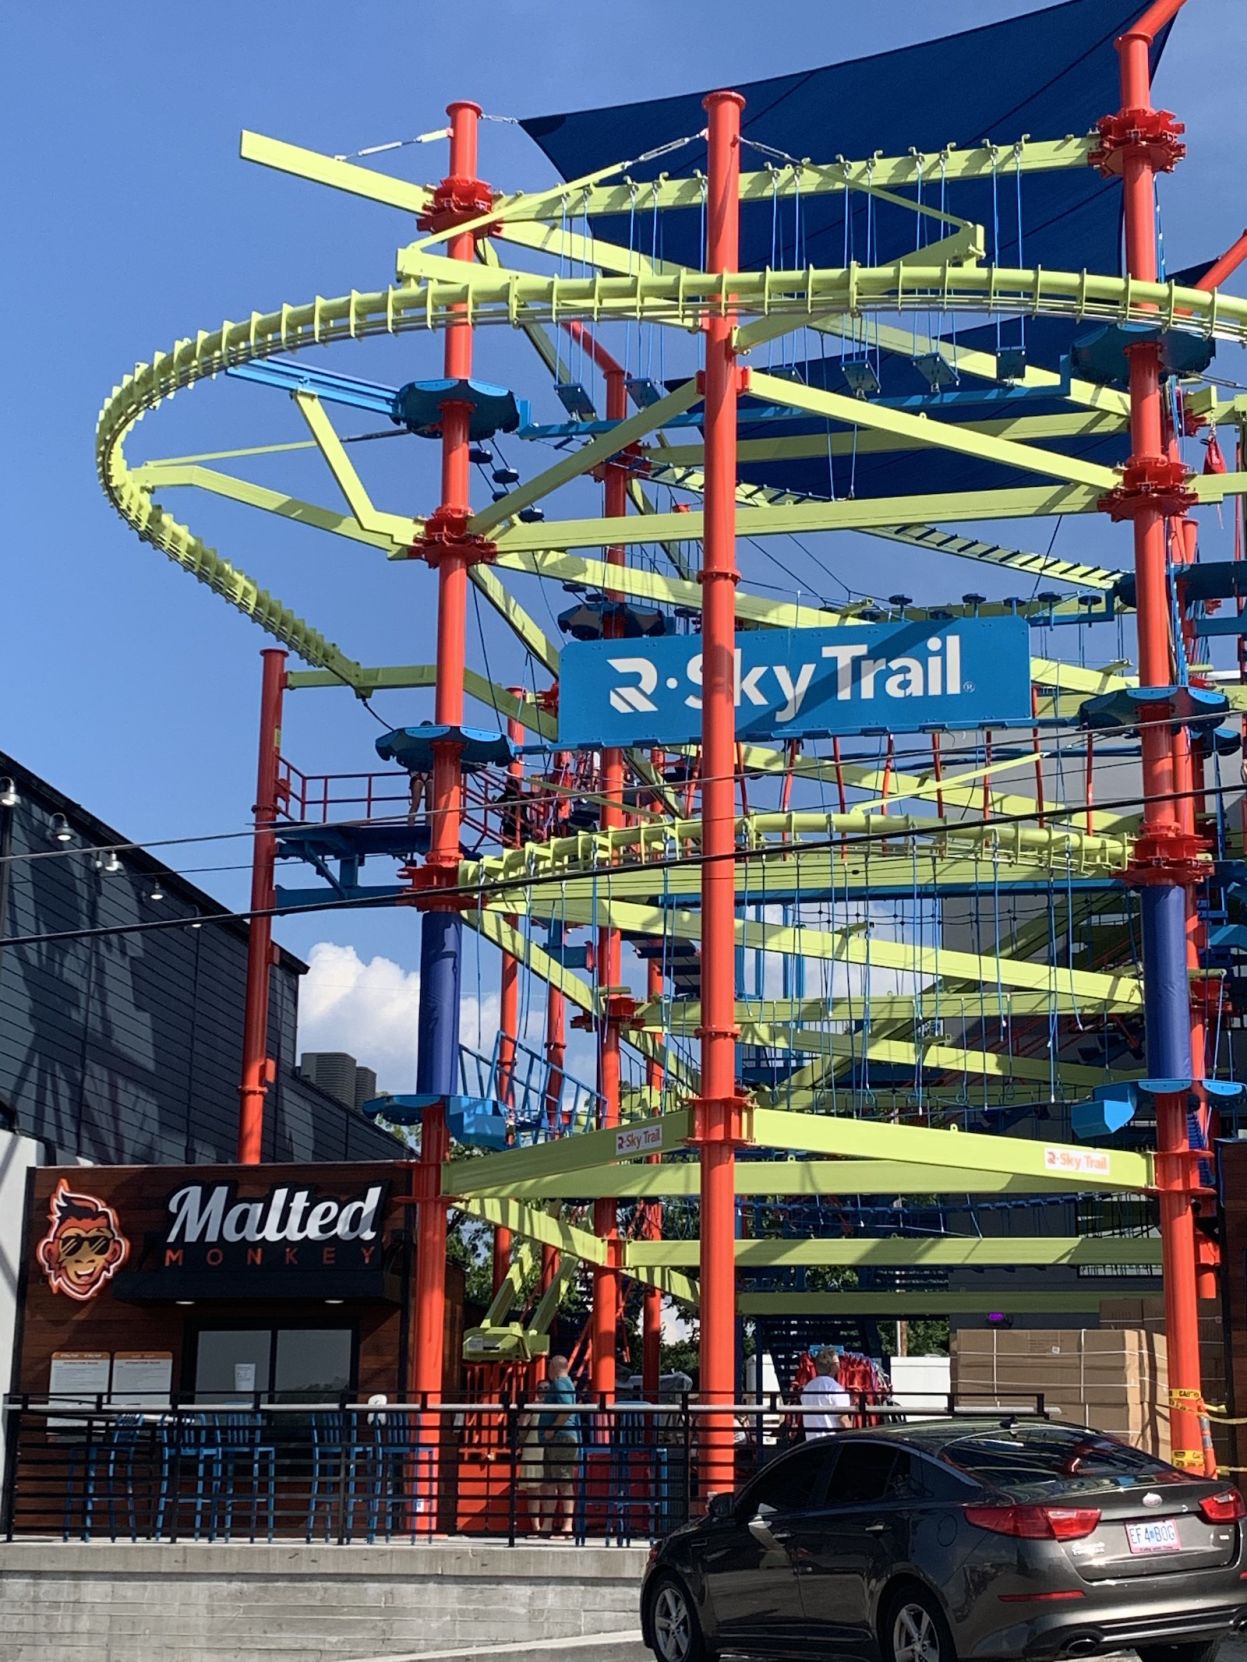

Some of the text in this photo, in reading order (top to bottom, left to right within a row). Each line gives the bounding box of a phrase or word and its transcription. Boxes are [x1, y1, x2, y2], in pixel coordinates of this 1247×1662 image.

[626, 1132, 642, 1150] Sky
[643, 1128, 660, 1145] Trail
[1060, 1152, 1082, 1170] Sky
[1084, 1155, 1107, 1169] Trail
[166, 1185, 382, 1242] Malted
[164, 1246, 375, 1267] MONKEY
